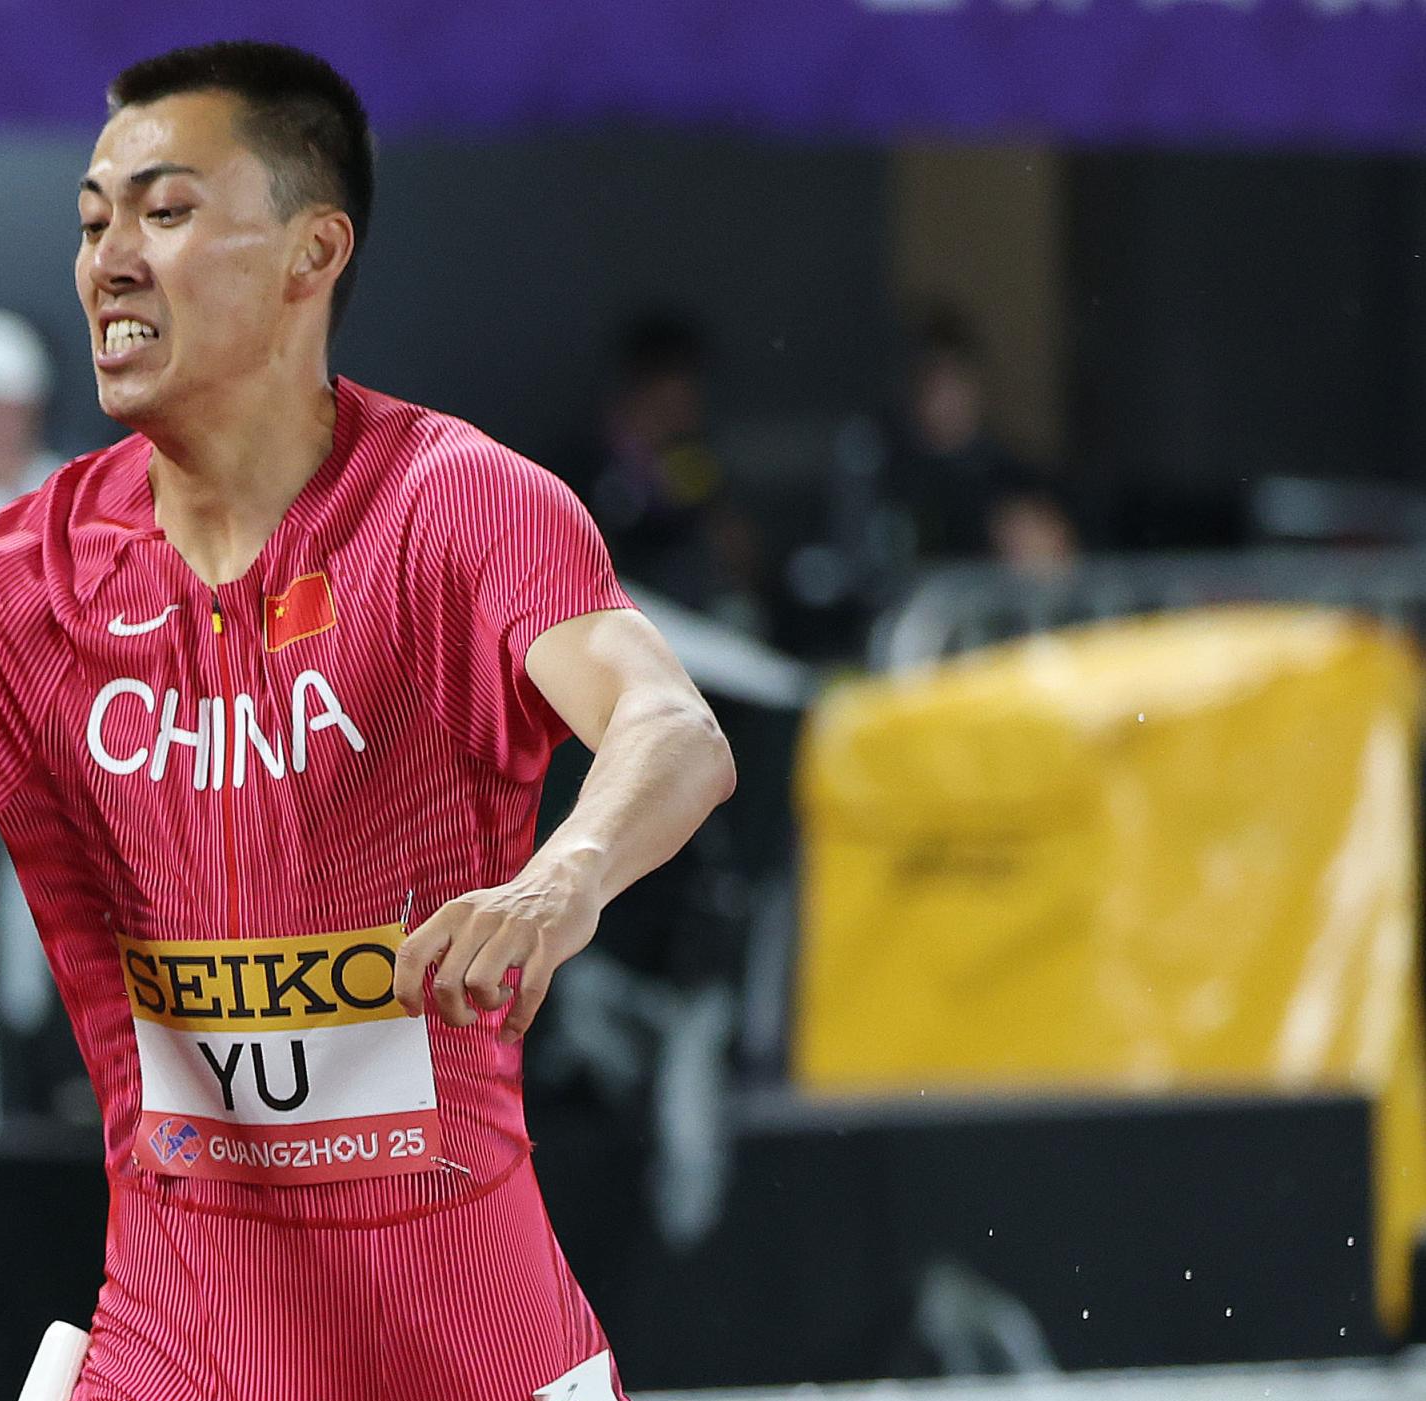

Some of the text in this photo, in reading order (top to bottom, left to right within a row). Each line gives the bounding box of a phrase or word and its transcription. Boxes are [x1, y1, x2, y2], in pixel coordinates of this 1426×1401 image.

[86, 669, 366, 793] CHINA
[126, 942, 398, 1020] SEIKO
[196, 1039, 310, 1112] YU
[208, 1126, 427, 1168] GUANGZHOU 25
